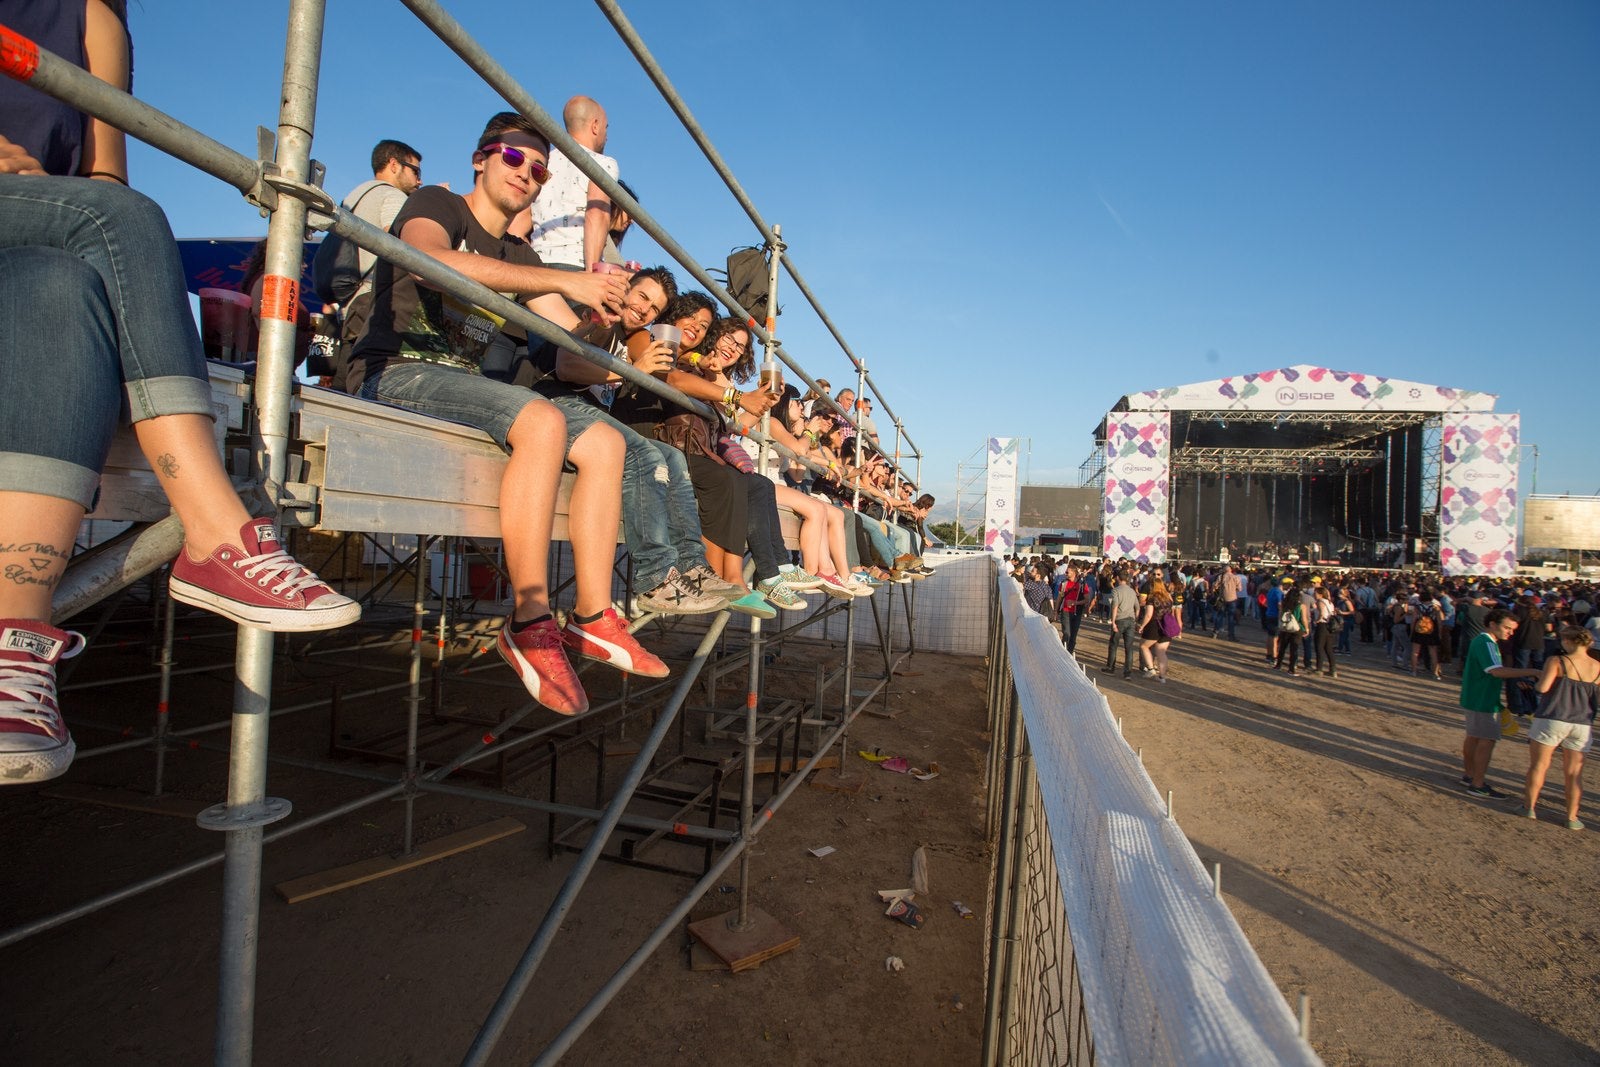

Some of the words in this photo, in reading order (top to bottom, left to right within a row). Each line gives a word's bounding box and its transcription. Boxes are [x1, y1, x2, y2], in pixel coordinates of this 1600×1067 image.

[286, 280, 296, 322] LAYHER
[465, 314, 496, 333] CONQUER
[460, 325, 490, 344] SWEDEN
[10, 636, 24, 648] ALL
[34, 642, 53, 656] STAR
[16, 631, 54, 645] CONVERSE
